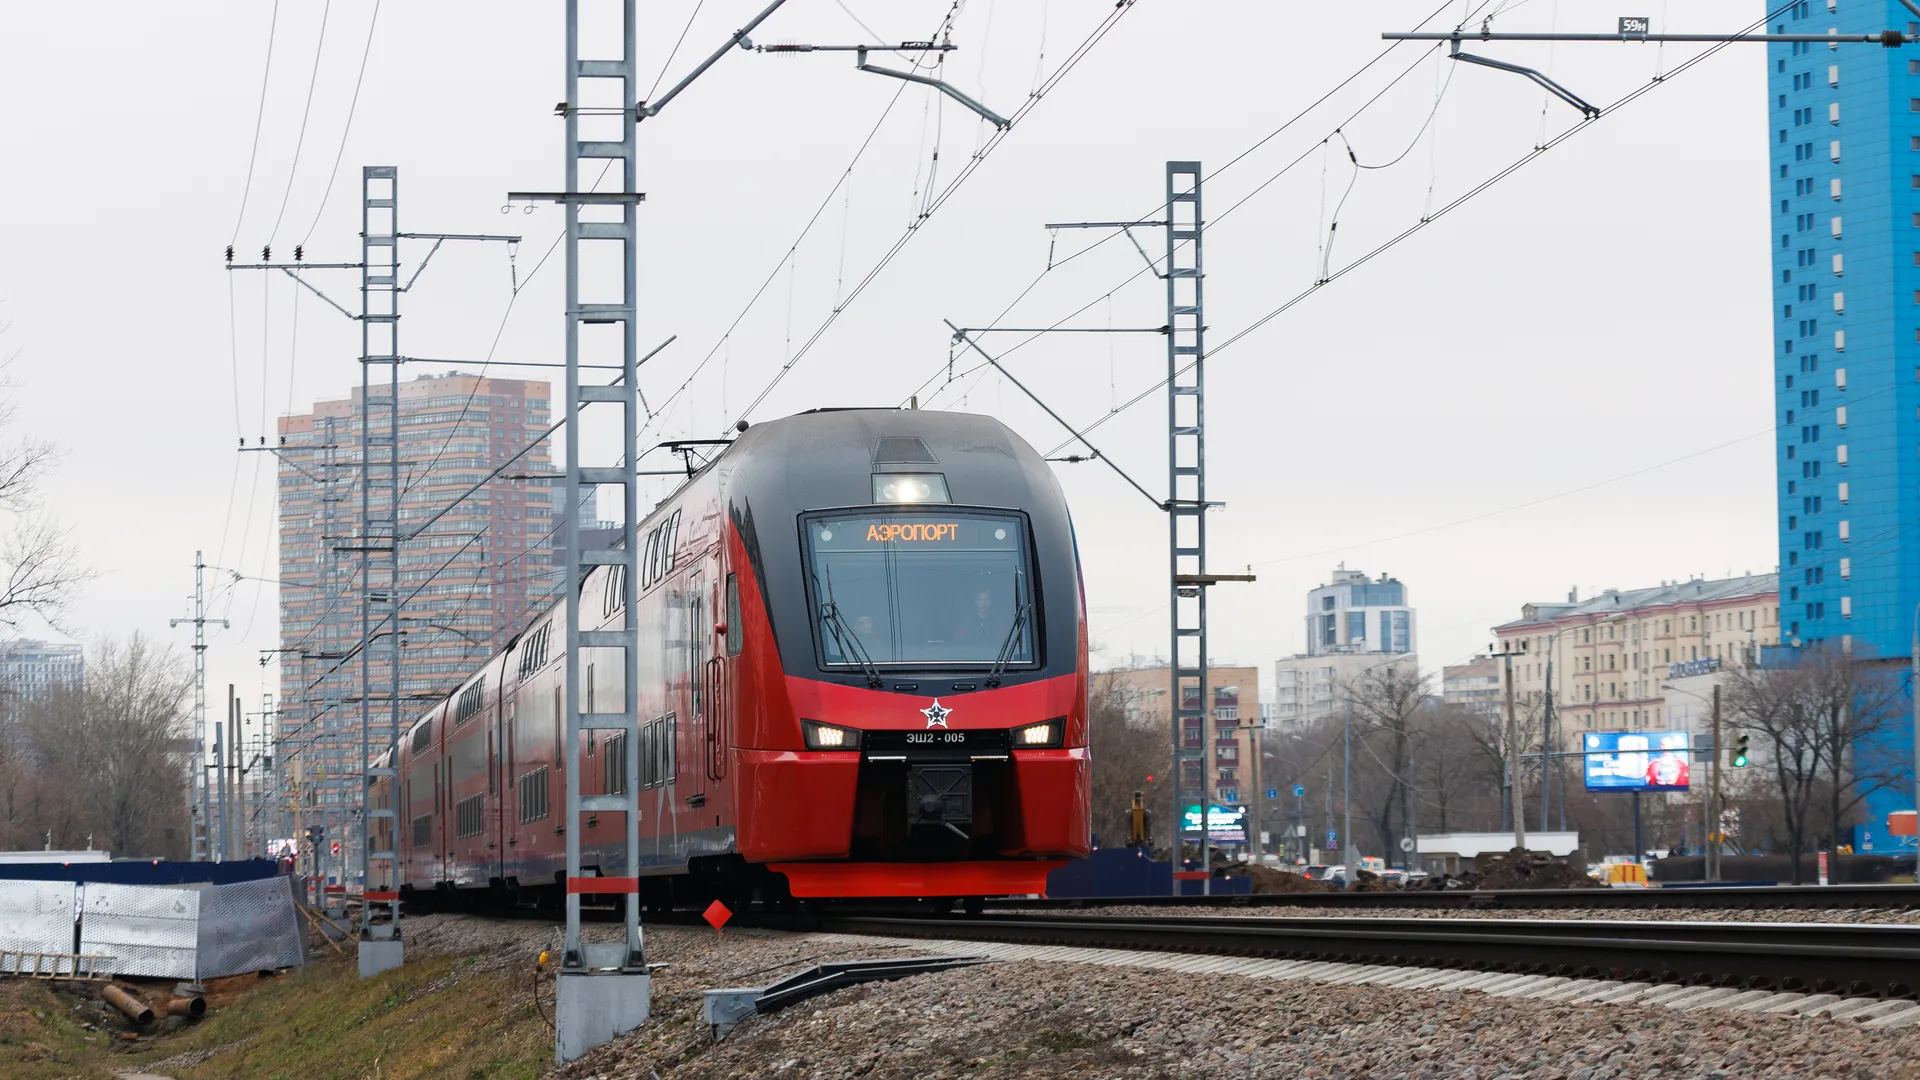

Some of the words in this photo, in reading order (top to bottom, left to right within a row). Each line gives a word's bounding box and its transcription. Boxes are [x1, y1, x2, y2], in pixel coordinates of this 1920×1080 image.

[866, 523, 959, 542] АЭРОПОРТ
[906, 733, 934, 743] ЭШ2
[944, 733, 965, 743] 005
